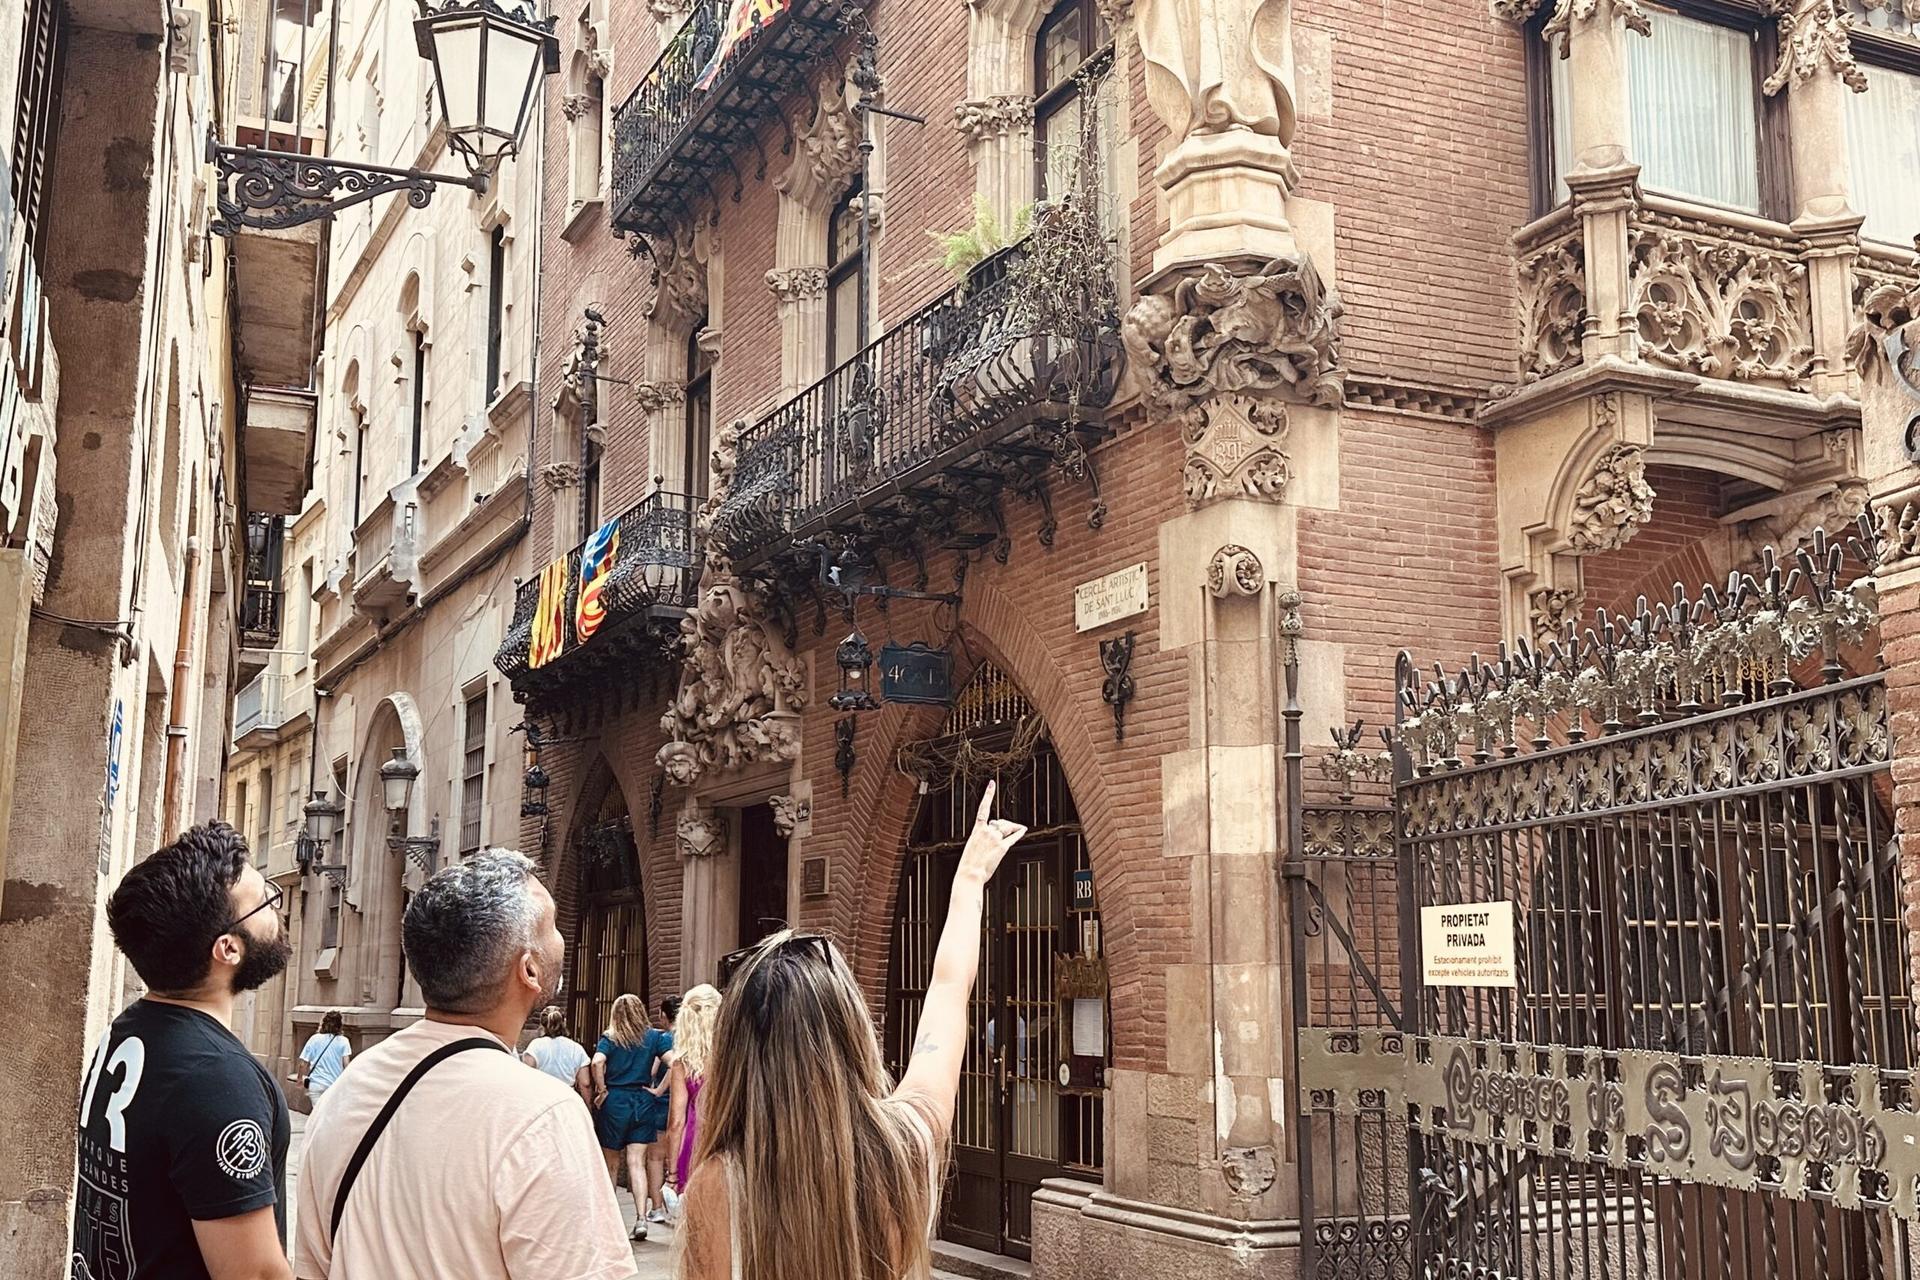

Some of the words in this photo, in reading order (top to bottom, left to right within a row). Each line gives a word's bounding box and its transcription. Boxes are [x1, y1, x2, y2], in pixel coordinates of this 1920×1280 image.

[1080, 580, 1107, 600] CERCLE
[1084, 600, 1094, 615] DE
[1096, 592, 1113, 610] SANT
[1076, 880, 1093, 899] RB
[1441, 912, 1490, 928] PROPIETAT
[1446, 932, 1486, 947] PRIVADA
[1433, 955, 1477, 965] Estacionament
[1451, 968, 1476, 977] vehicles
